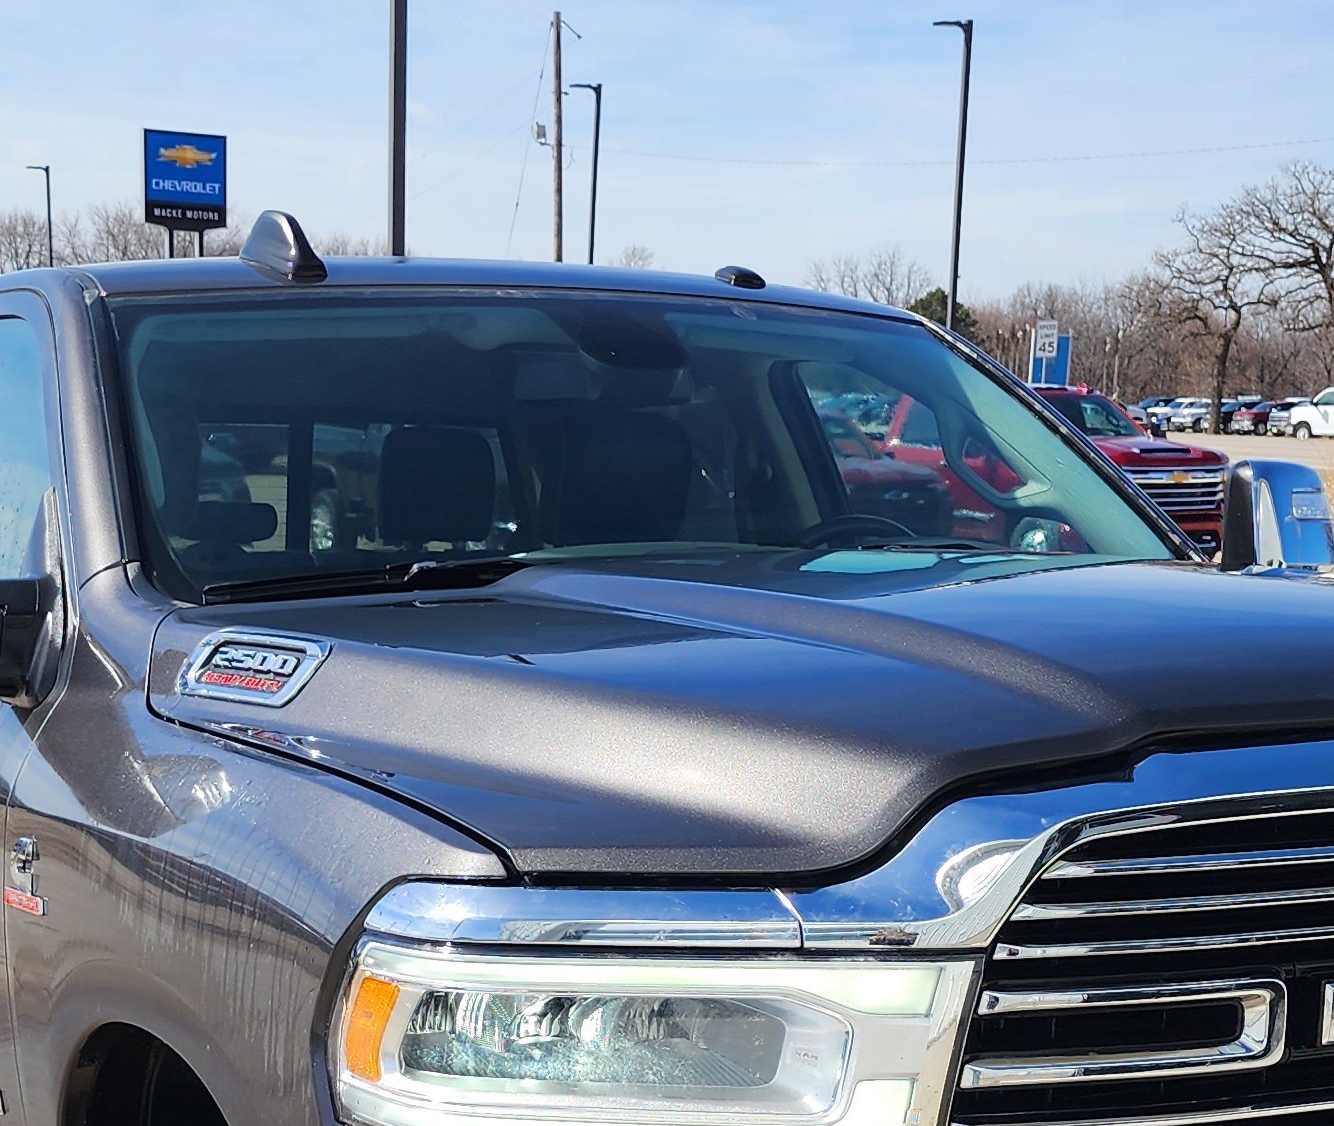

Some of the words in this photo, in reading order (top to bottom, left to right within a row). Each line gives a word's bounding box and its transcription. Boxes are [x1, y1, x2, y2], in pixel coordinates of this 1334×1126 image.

[151, 178, 221, 195] CHEVROLET
[153, 207, 183, 219] MACKE
[186, 209, 219, 221] MOTORS
[1038, 341, 1055, 354] 45
[213, 646, 300, 676] 2500
